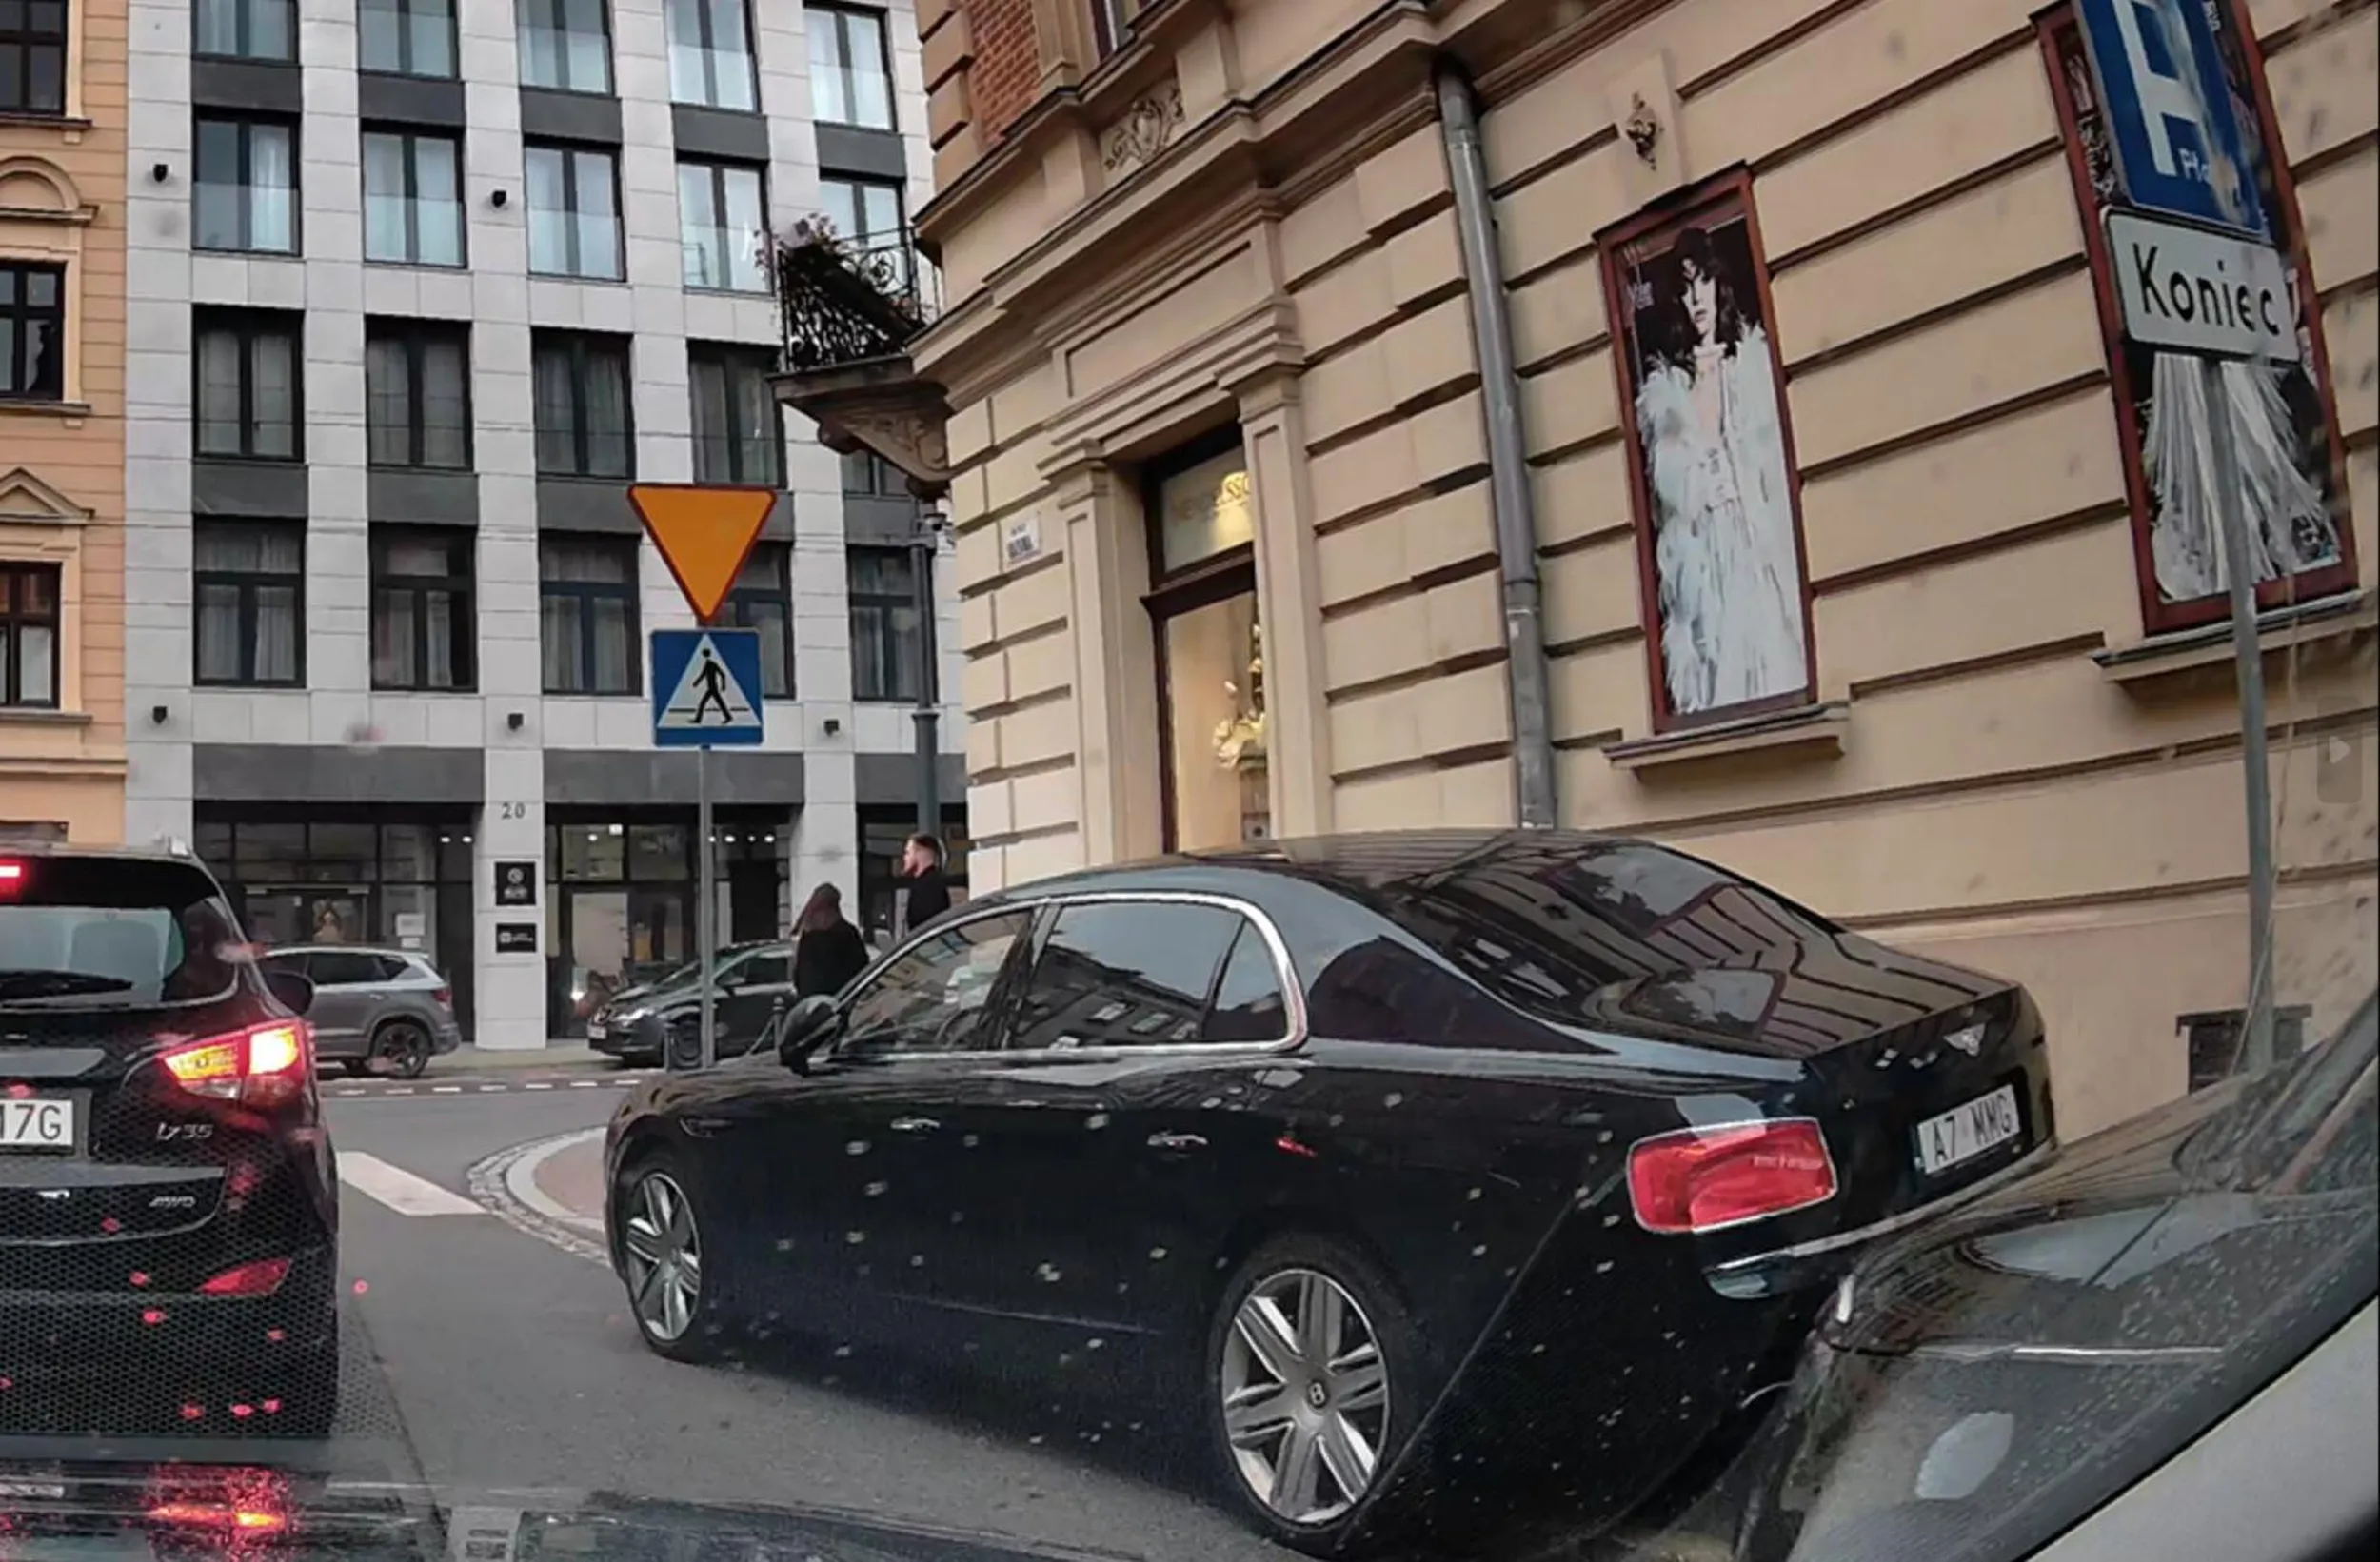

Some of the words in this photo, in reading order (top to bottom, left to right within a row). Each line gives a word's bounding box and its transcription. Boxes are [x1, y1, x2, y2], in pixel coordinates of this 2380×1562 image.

[2132, 242, 2280, 335] Koniec
[501, 801, 526, 820] 20
[1933, 1115, 1956, 1166] A7
[1970, 1093, 2012, 1146] MMG
